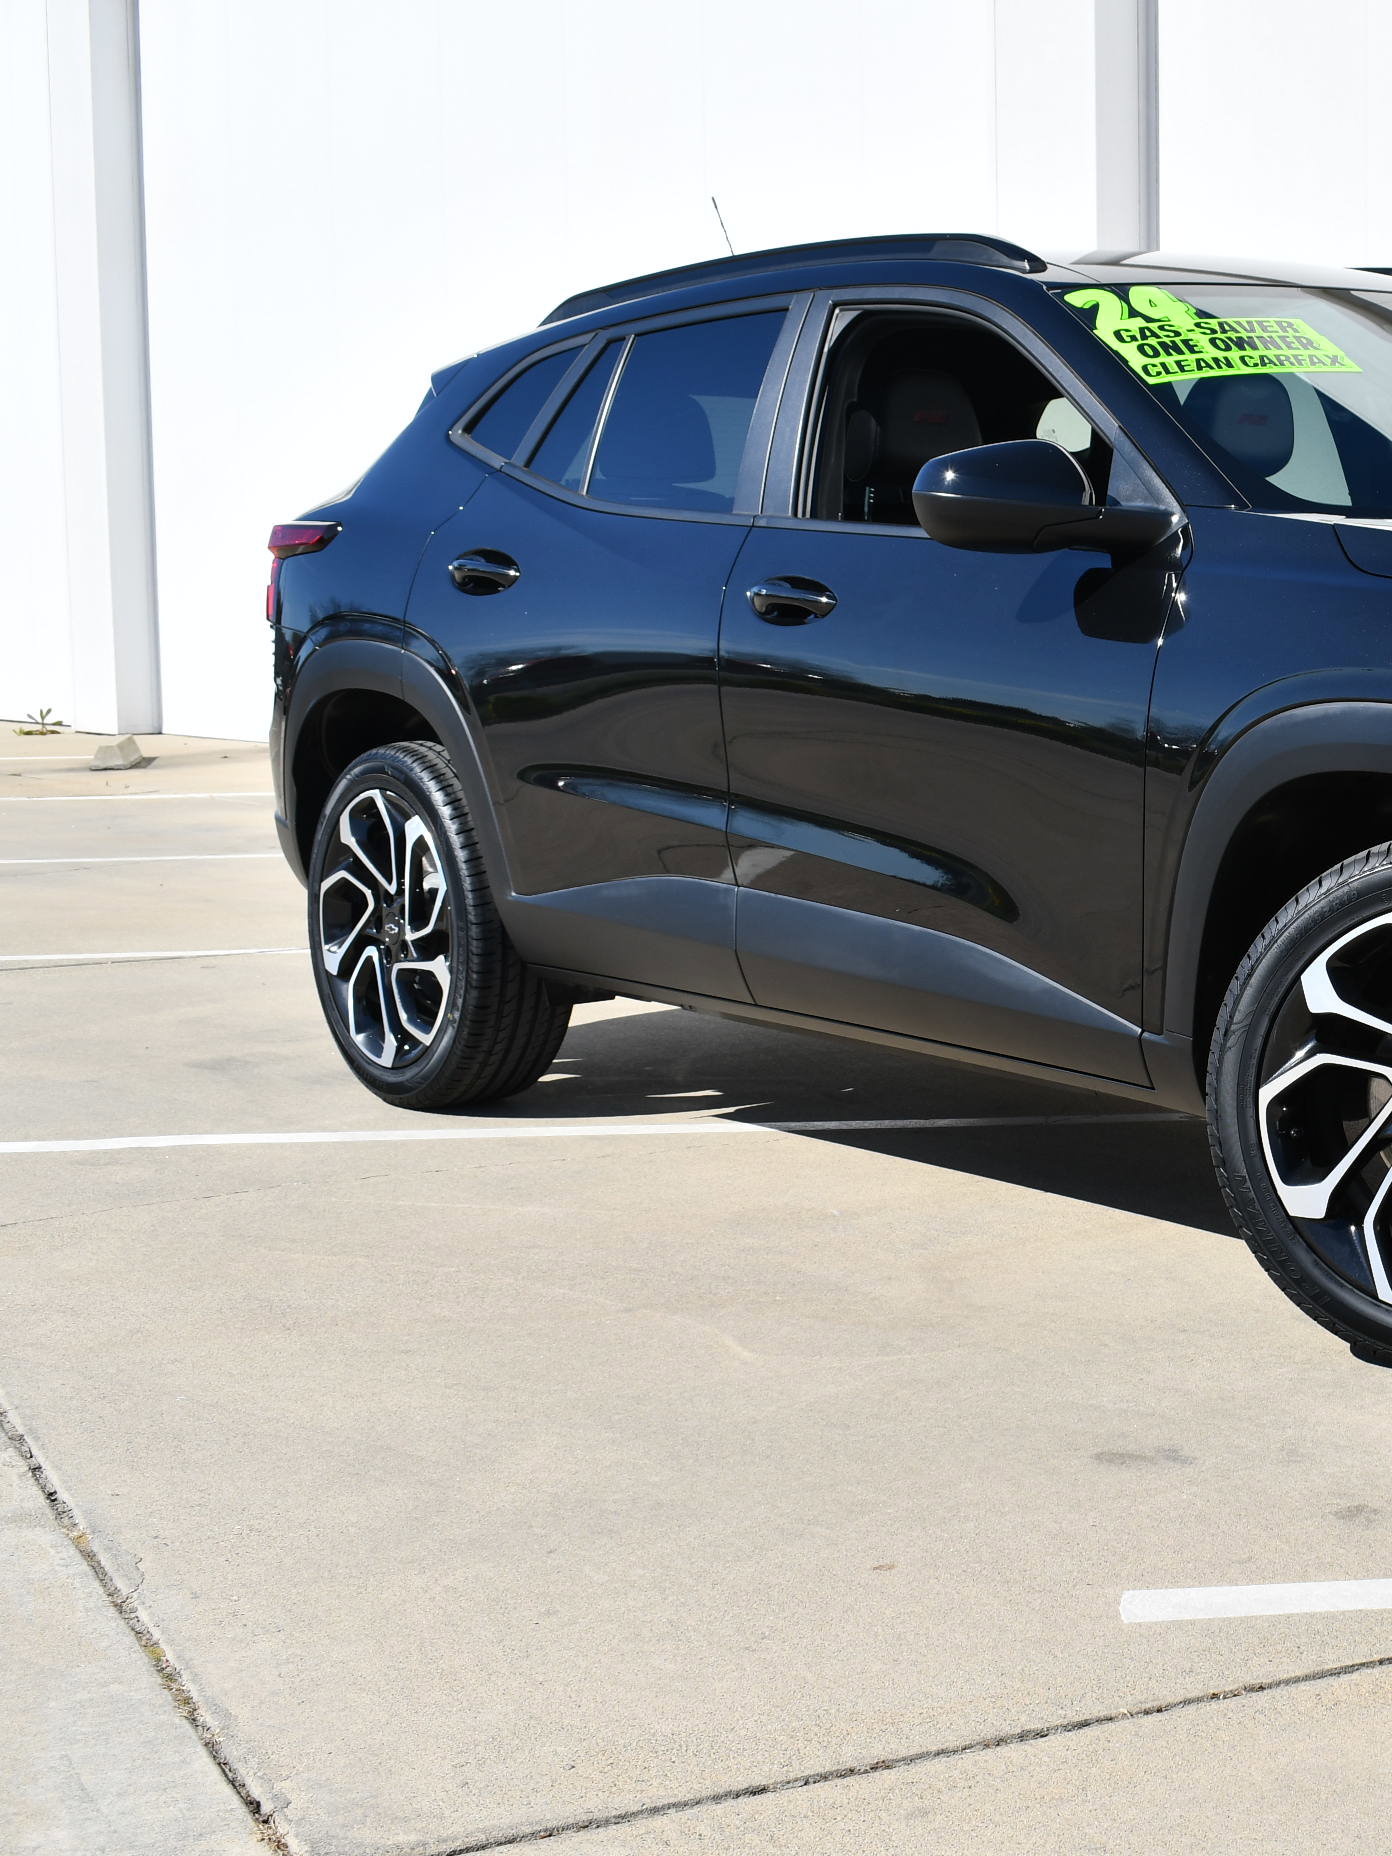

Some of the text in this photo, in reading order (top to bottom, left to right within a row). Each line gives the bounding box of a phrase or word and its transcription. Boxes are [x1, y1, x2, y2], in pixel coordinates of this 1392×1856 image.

[1136, 335, 1320, 359] ONE OWNER
[1141, 354, 1345, 378] CLEAN CARFAX
